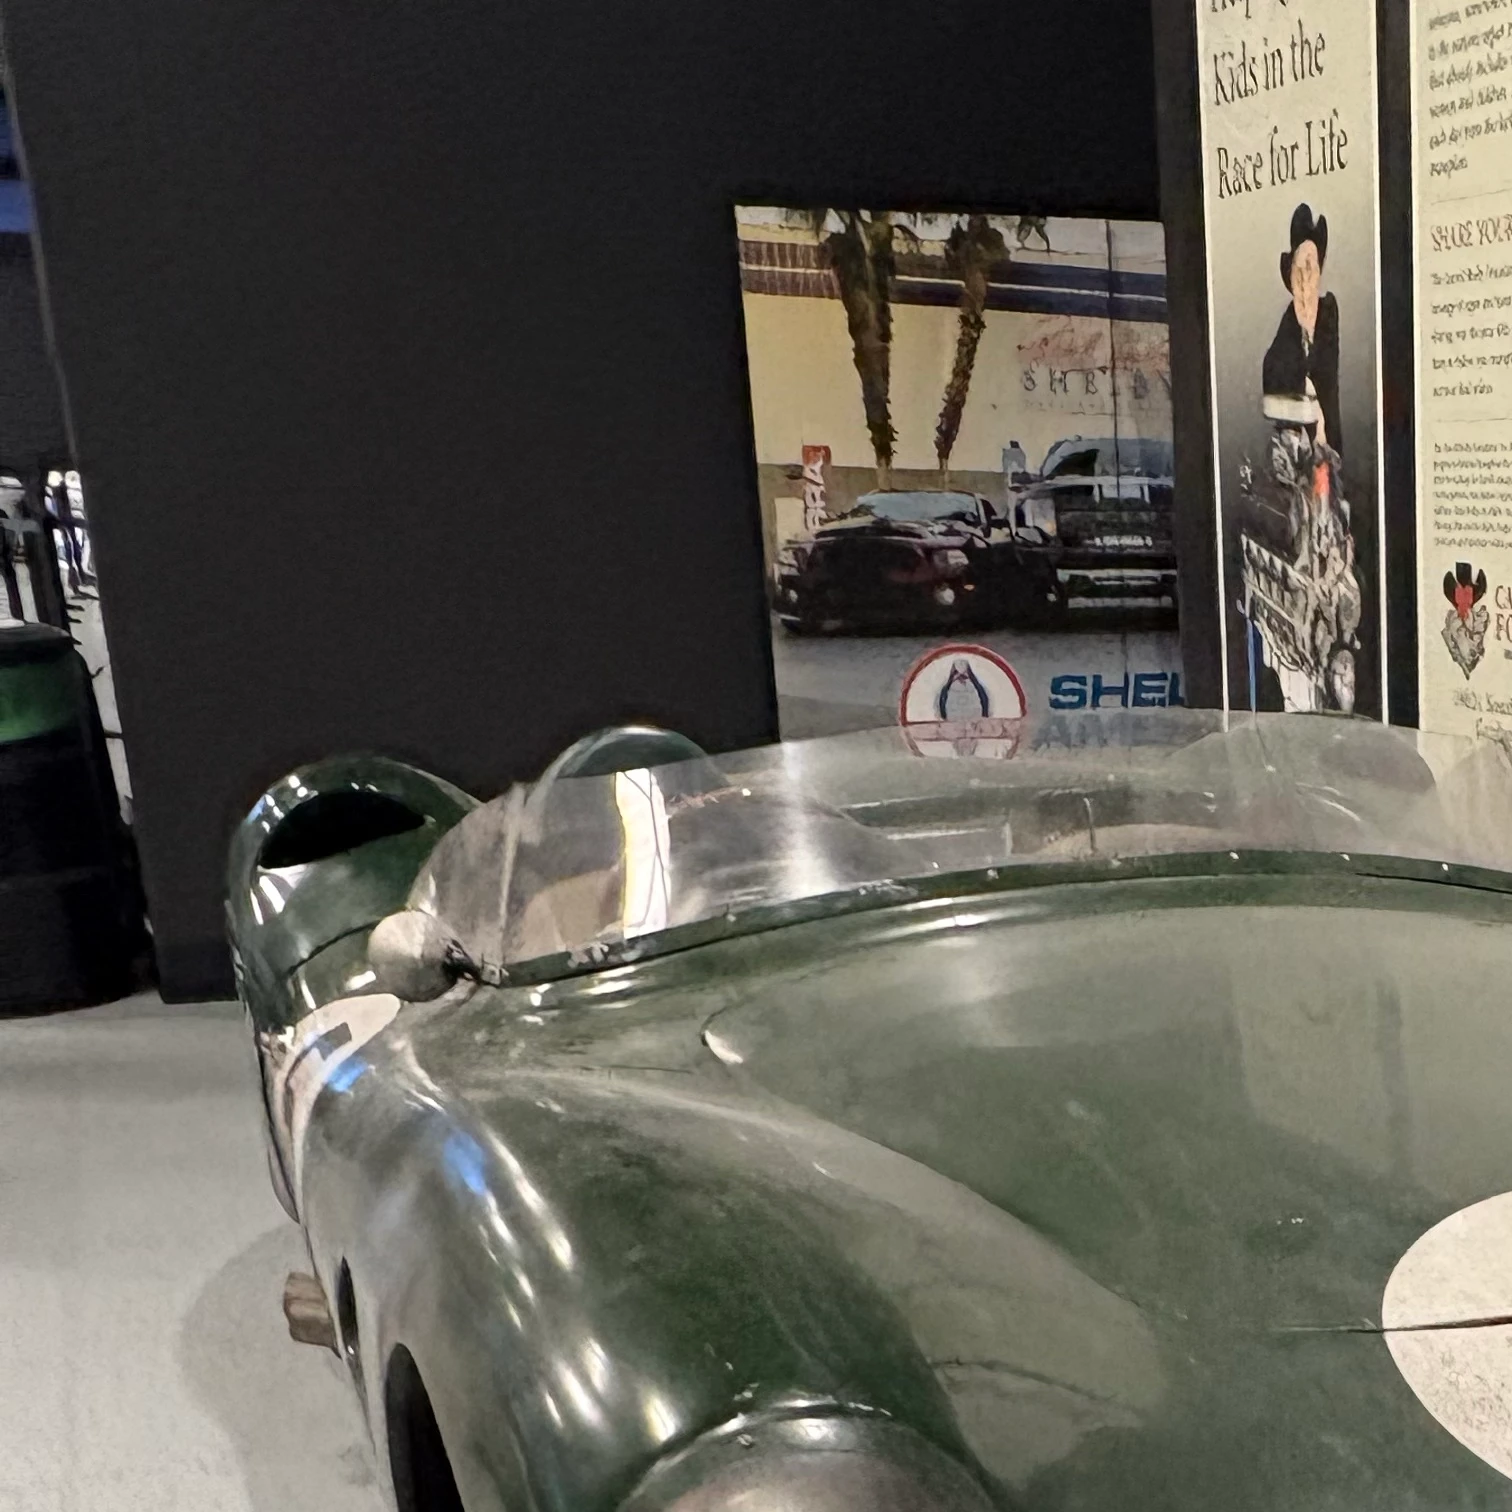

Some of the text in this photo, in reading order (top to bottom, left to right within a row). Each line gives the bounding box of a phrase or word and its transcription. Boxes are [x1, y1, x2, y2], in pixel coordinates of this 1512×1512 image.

[1214, 18, 1325, 106] Kids in the
[1217, 108, 1348, 199] Race for Life
